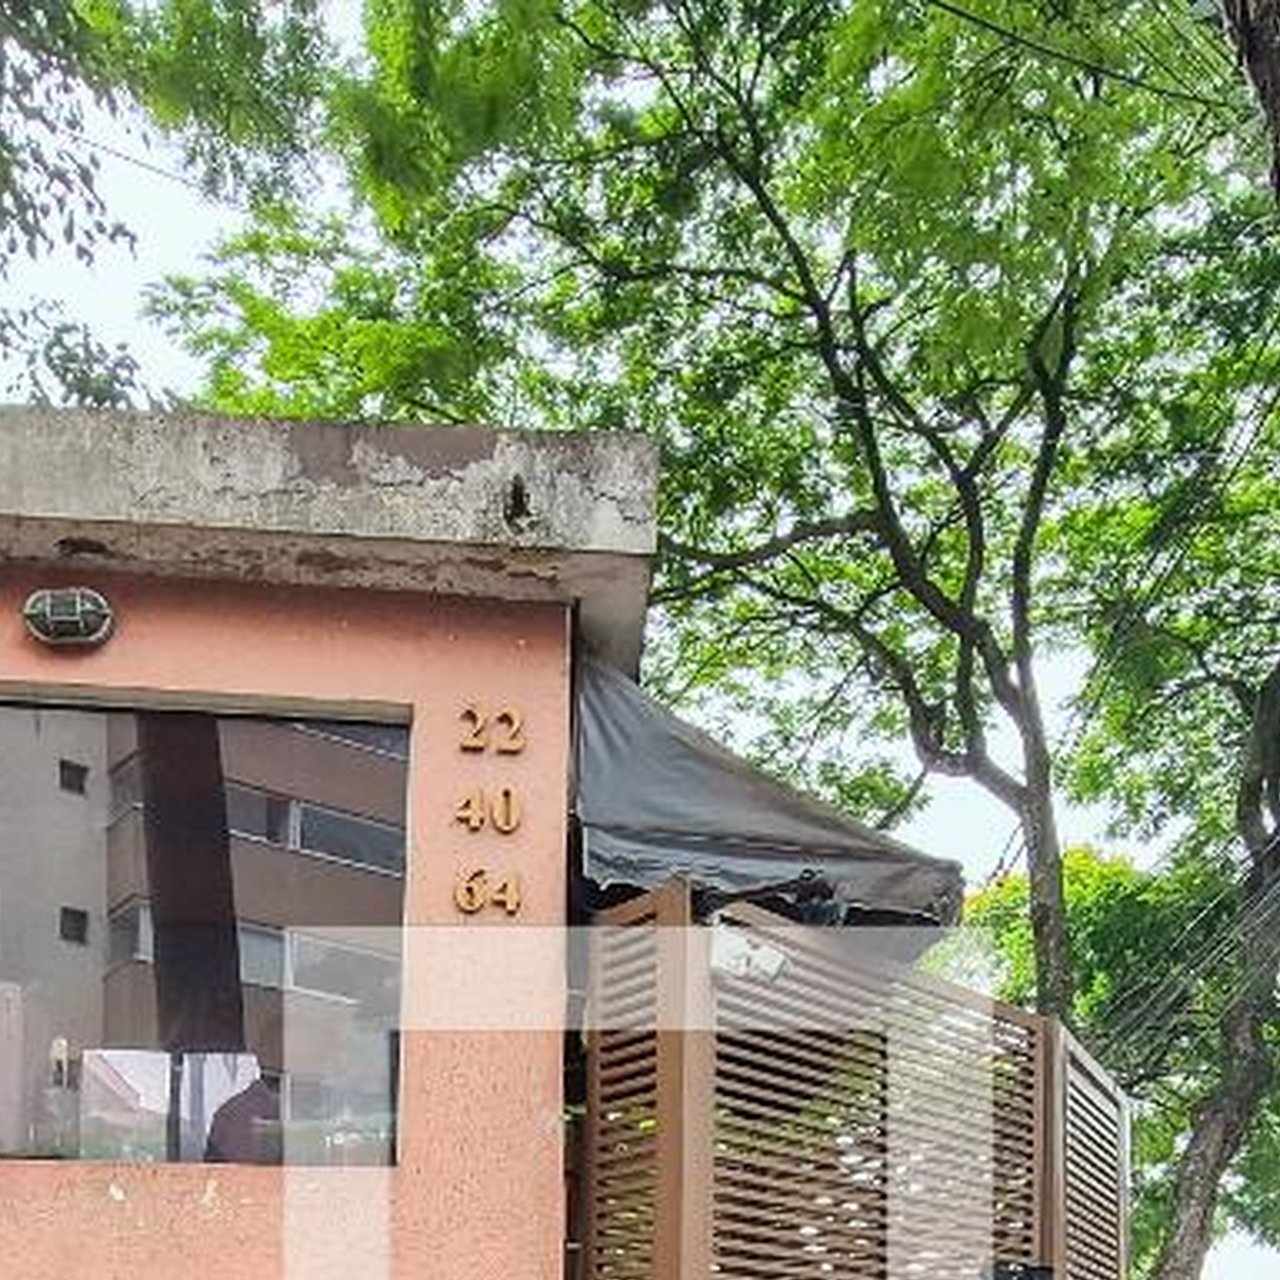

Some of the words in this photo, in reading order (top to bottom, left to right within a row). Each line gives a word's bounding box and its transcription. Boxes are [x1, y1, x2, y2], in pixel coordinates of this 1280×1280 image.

[459, 704, 527, 755] 22
[456, 785, 521, 836] 40
[454, 864, 522, 916] 64
